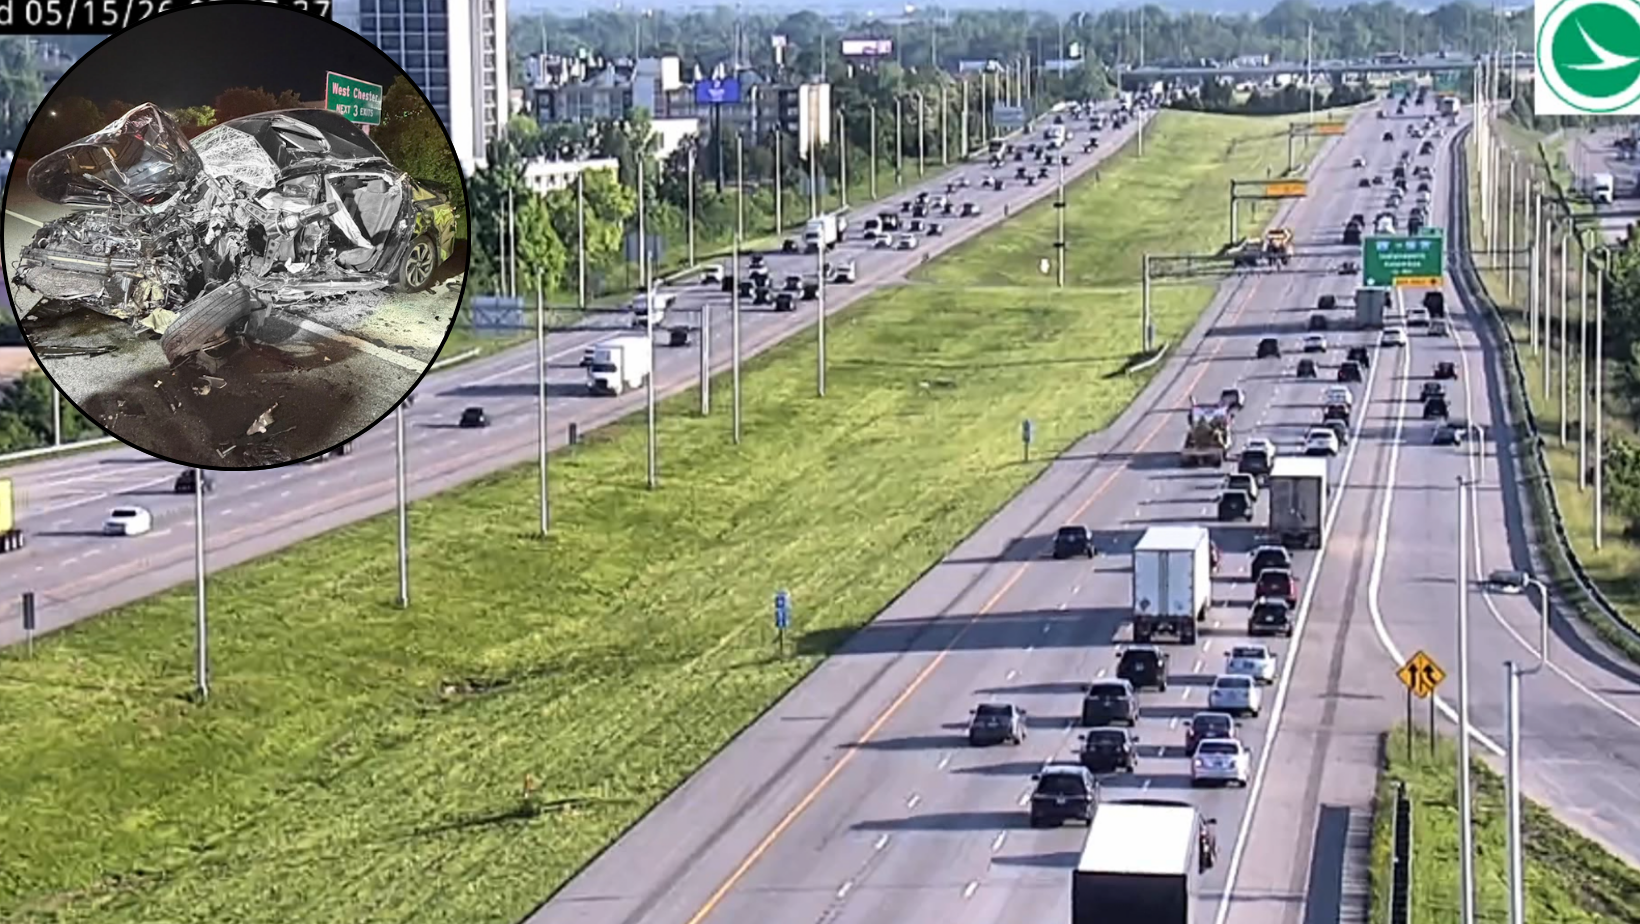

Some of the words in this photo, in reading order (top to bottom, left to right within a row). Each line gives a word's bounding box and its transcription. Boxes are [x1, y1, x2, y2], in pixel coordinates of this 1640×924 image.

[332, 82, 350, 97] West
[353, 87, 379, 102] Chester
[336, 103, 351, 115] NEXT
[353, 104, 359, 117] 3
[360, 107, 374, 117] EXITS
